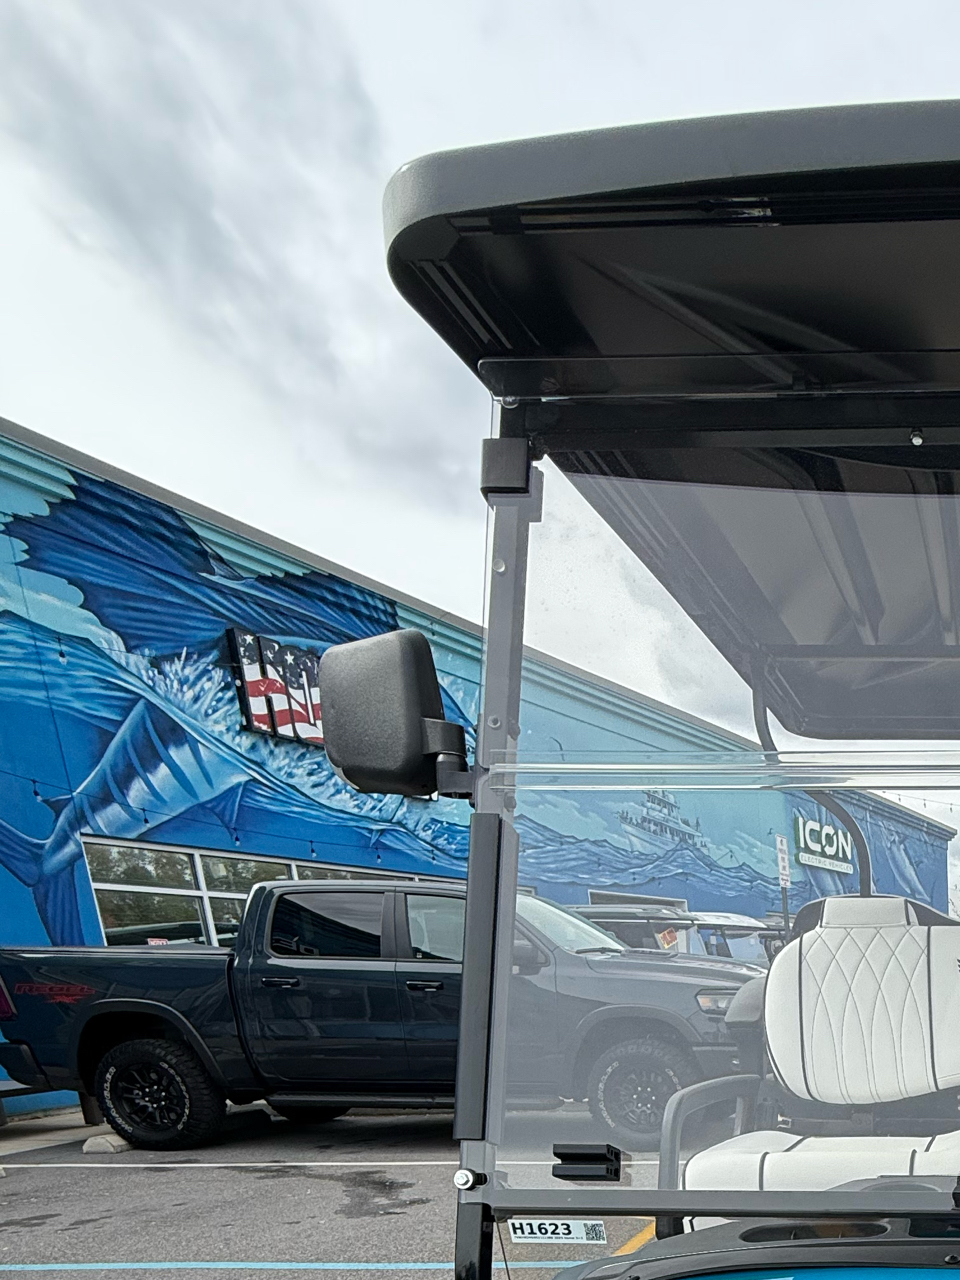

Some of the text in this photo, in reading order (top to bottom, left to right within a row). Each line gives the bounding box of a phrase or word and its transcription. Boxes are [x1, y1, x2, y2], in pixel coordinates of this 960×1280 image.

[798, 816, 852, 861] ICON
[801, 854, 828, 868] ELECTRIC
[511, 1222, 572, 1236] H1623
